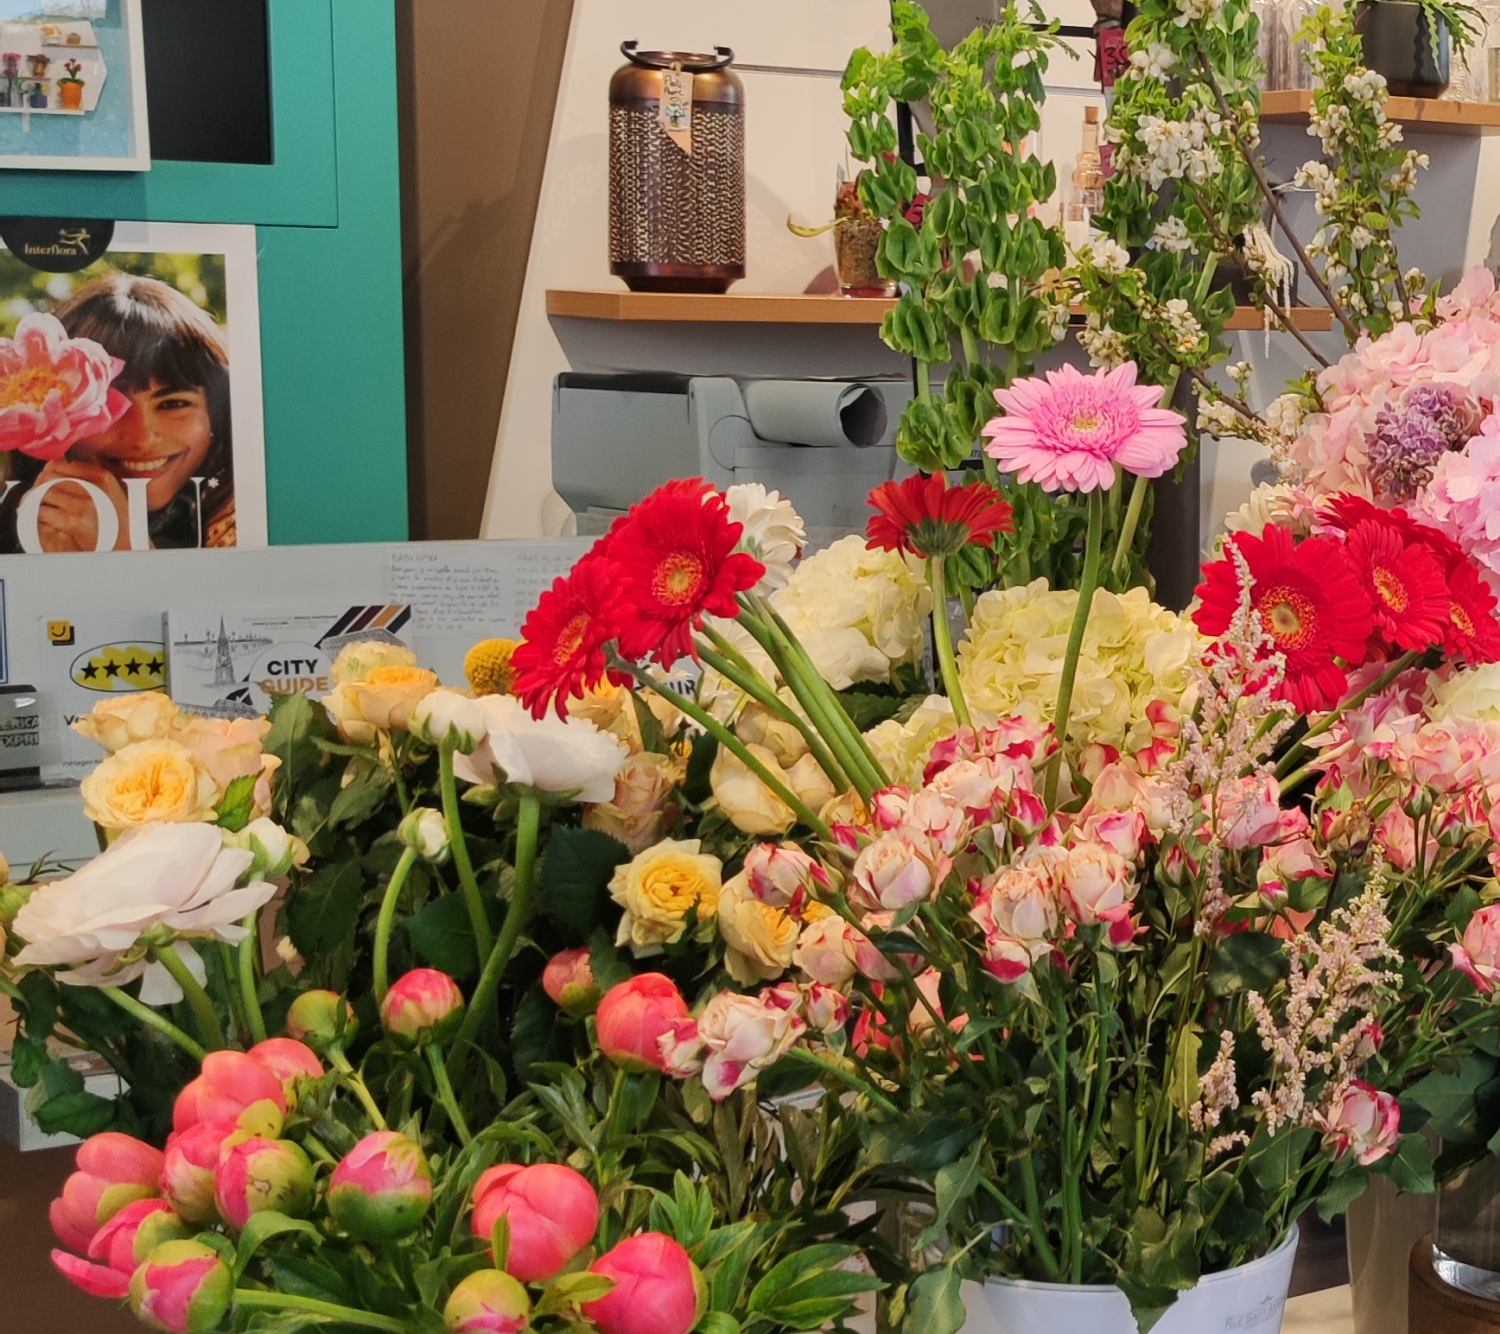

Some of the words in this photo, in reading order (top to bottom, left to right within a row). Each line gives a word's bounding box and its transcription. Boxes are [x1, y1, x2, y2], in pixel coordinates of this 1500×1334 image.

[24, 243, 77, 256] Interflora
[267, 659, 319, 676] CITY
[260, 676, 329, 694] GUIDE
